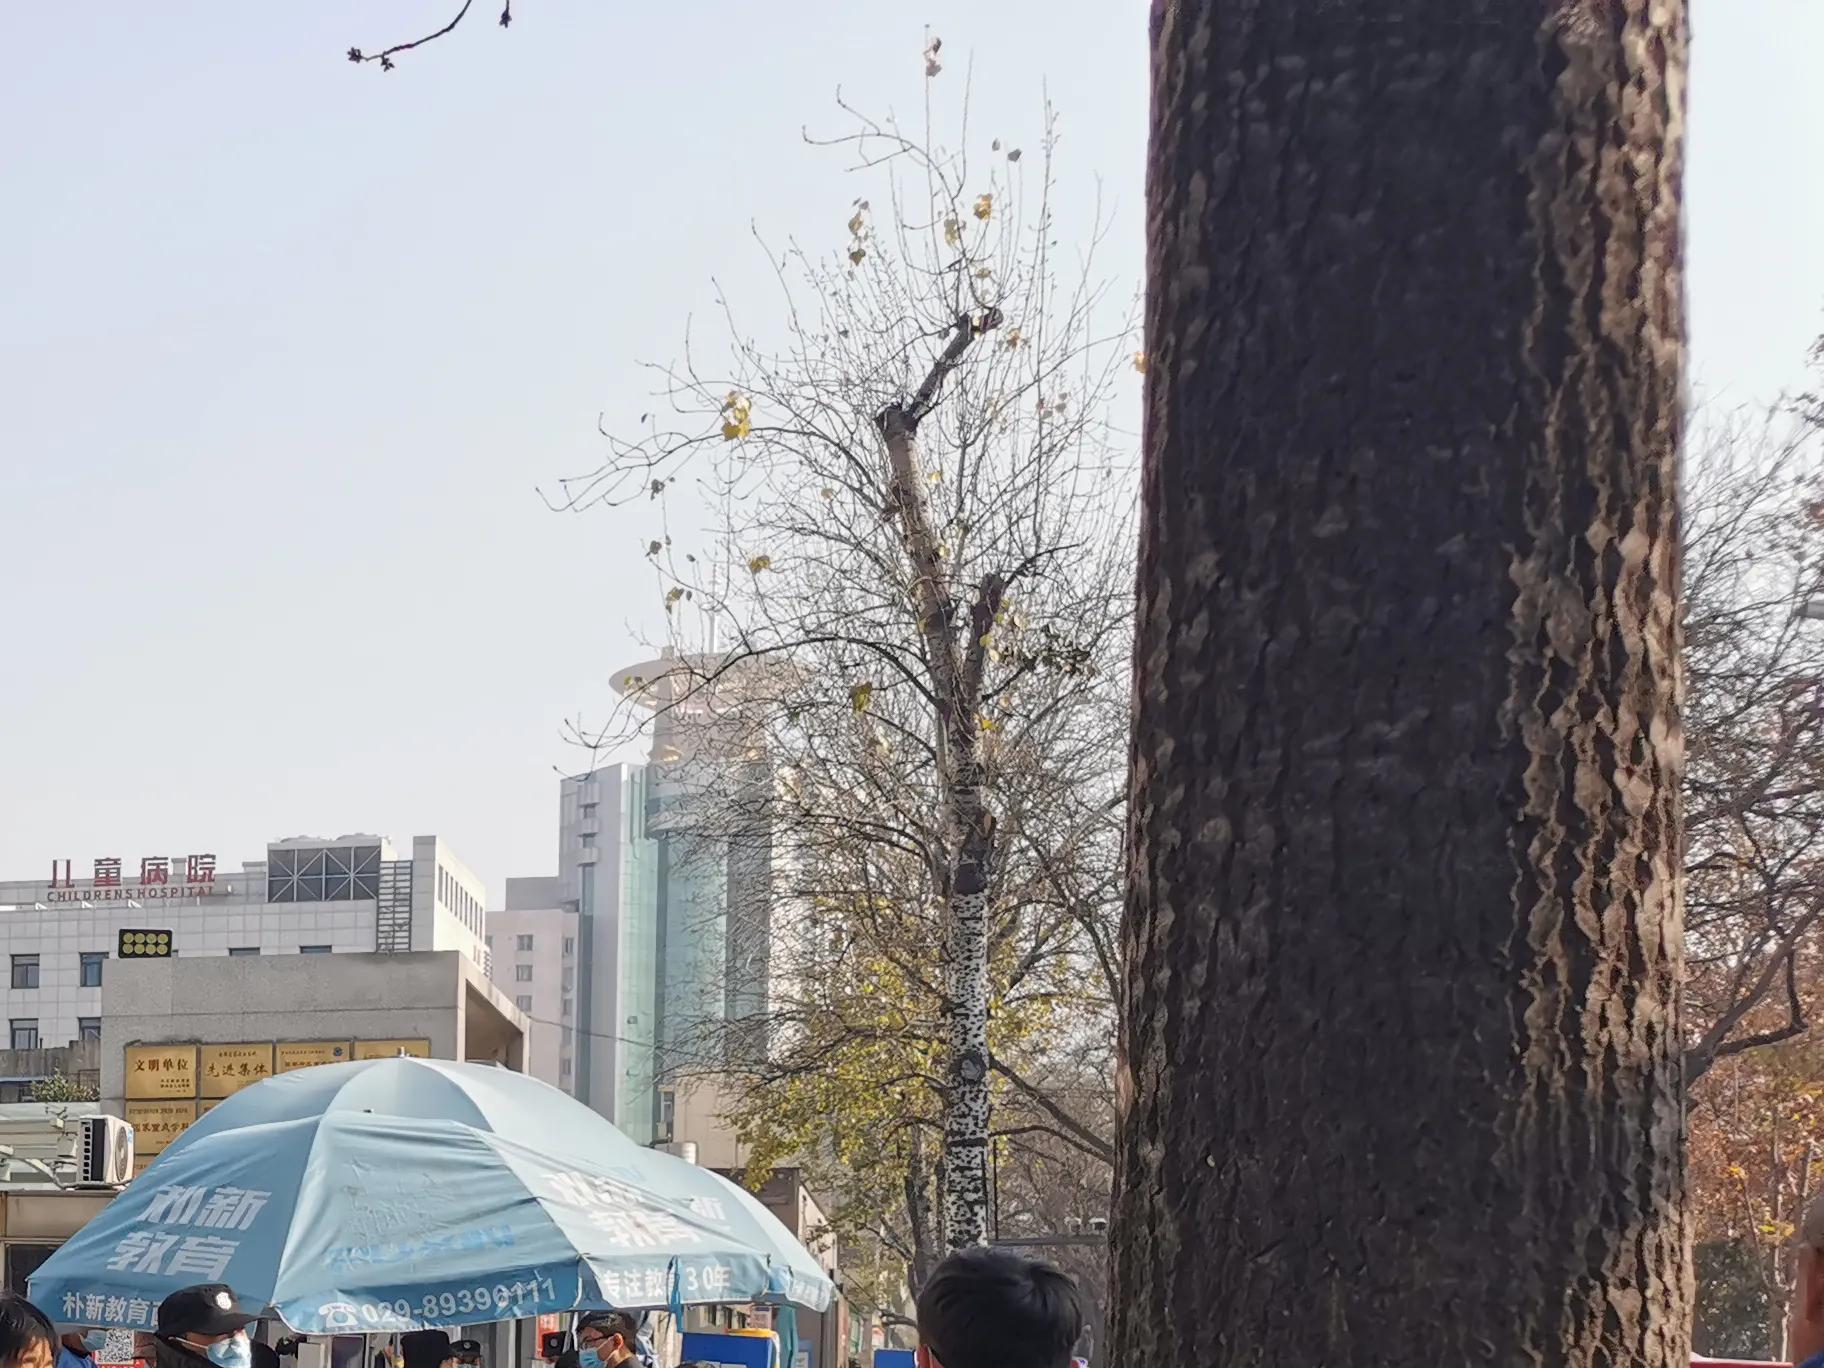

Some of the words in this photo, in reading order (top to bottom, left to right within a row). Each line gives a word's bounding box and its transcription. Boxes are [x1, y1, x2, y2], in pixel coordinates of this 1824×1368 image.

[134, 1058, 189, 1073] 文明单位
[106, 1230, 241, 1282] 教育
[601, 1263, 732, 1301] 专注教30年
